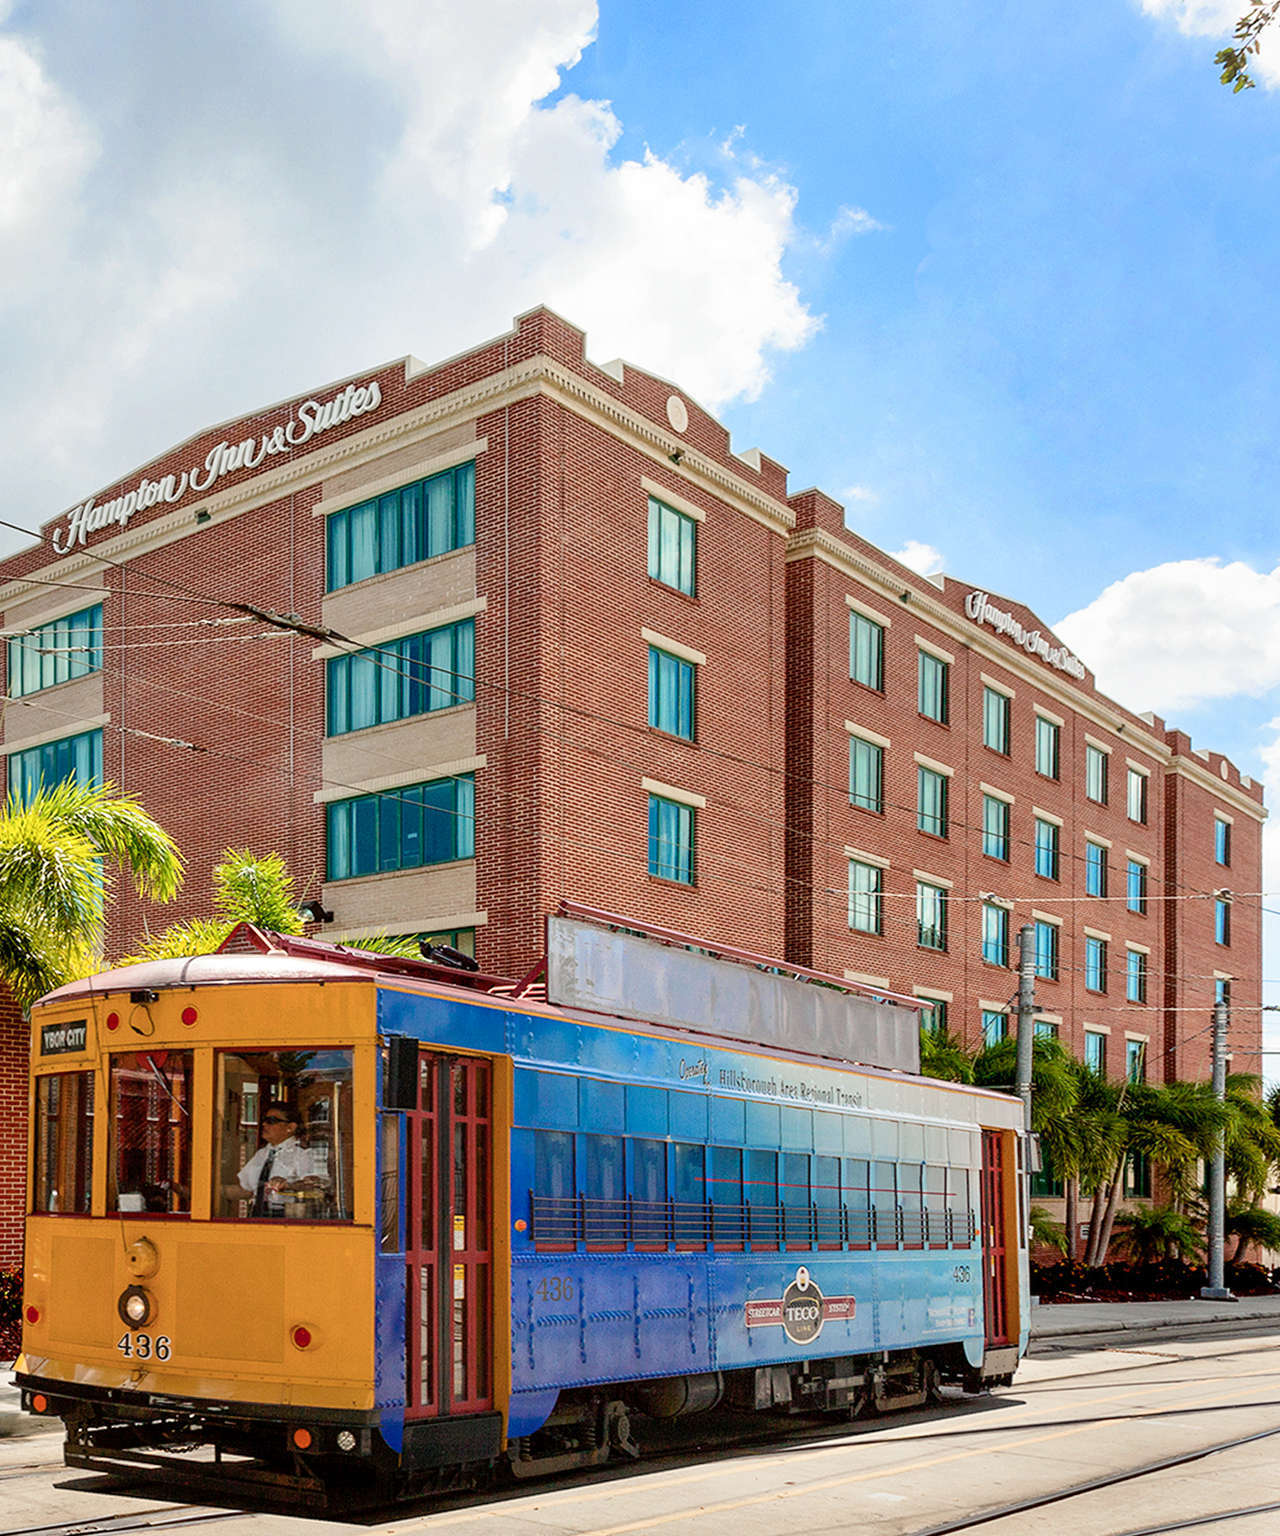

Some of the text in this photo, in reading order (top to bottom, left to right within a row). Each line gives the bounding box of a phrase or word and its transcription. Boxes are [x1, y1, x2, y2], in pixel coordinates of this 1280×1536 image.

[53, 381, 382, 554] Hampton Inn & Suites
[965, 591, 1027, 645] Hampton
[44, 1027, 86, 1049] YBOR CITY
[719, 1069, 777, 1097] Hillsborough
[780, 1080, 799, 1099] Area
[800, 1082, 834, 1106] Regional
[837, 1088, 862, 1108] Transit
[953, 1265, 971, 1283] 436
[535, 1276, 574, 1302] 436
[748, 1307, 781, 1318] STREETCAR
[786, 1306, 820, 1321] TECO
[117, 1332, 172, 1362] 436
